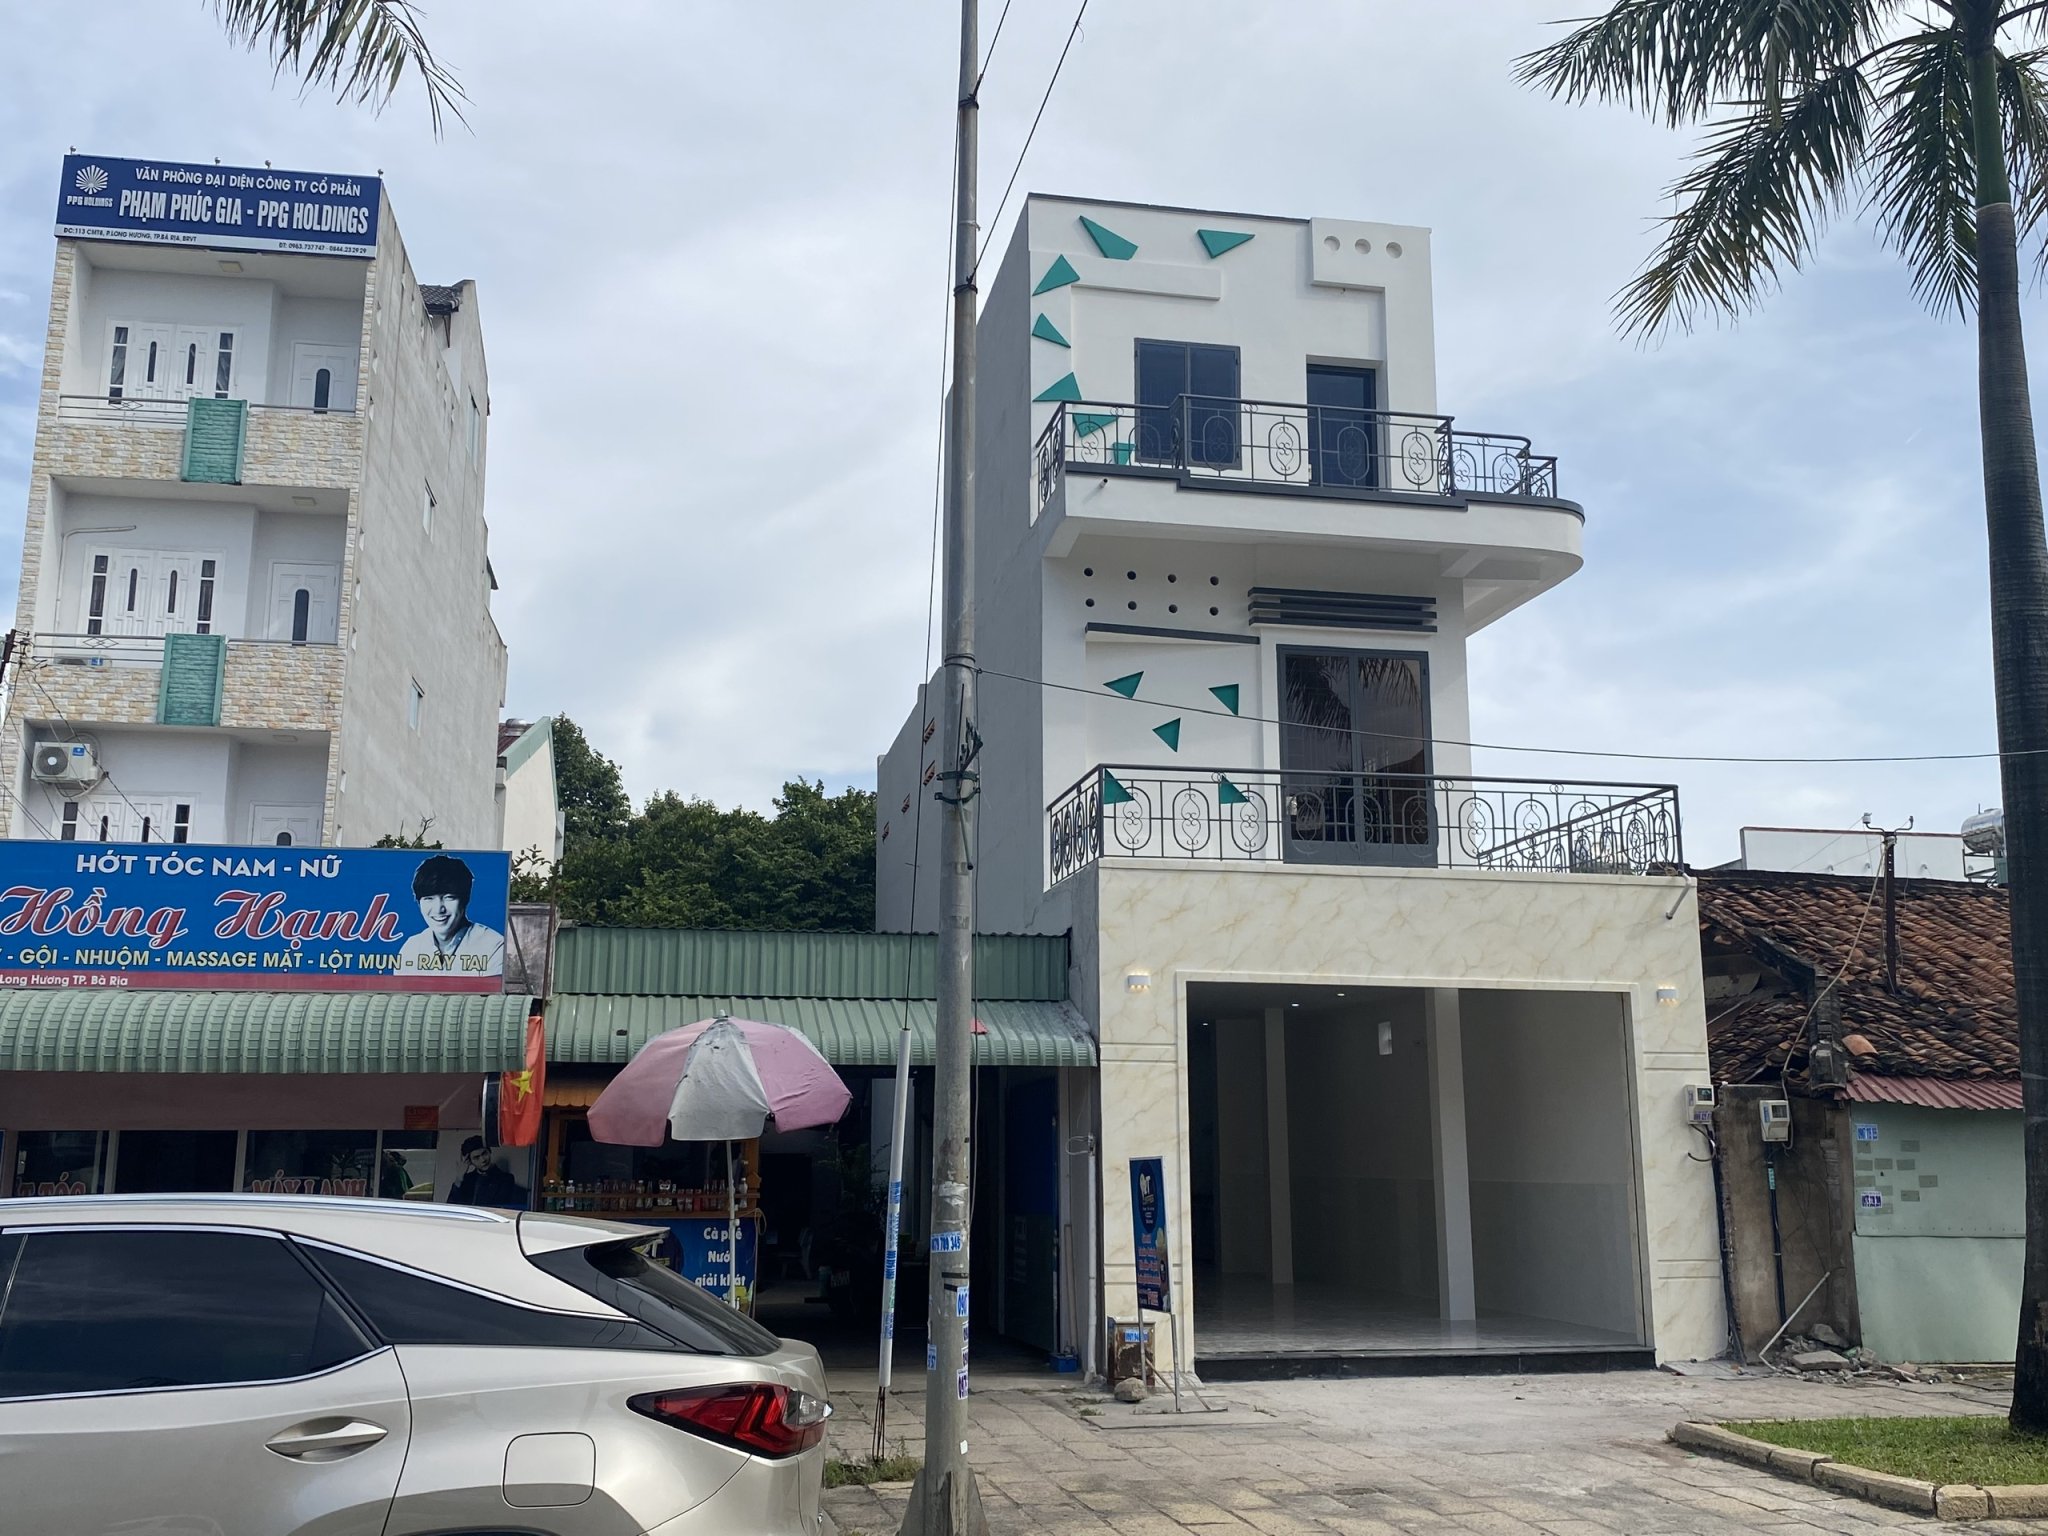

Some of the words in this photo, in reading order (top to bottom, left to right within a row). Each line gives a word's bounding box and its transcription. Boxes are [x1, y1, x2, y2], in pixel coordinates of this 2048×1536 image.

[135, 166, 159, 180] VĂN
[163, 168, 202, 184] PHÒNG
[205, 173, 226, 188] ĐẠI
[229, 173, 254, 190] DIỆN
[256, 176, 291, 191] CÔNG
[295, 180, 307, 192] TY
[310, 177, 328, 194] CỔ
[330, 179, 361, 197] PHẦN
[66, 195, 83, 206] PPG
[119, 190, 167, 222] PHẠM
[170, 190, 213, 223] PHÚC
[215, 196, 242, 225] GIA
[257, 200, 289, 229] PPG
[292, 202, 369, 234] HOLDINGS
[76, 850, 138, 874] HỚT
[145, 851, 205, 876] TÓC
[212, 857, 276, 877] NAM
[300, 854, 343, 878] NỮ
[0, 885, 188, 949] Hồng
[214, 889, 403, 949] Hạnh
[19, 944, 58, 969] GỘI
[75, 946, 149, 970] NHUỘM
[166, 951, 257, 968] MASSAGE
[263, 949, 304, 973] MẶT
[319, 949, 354, 974] LỘT
[359, 953, 402, 975] MỤN
[417, 951, 456, 971] RÁY
[460, 954, 488, 972] TAI
[0, 974, 28, 987] Long
[31, 974, 69, 987] Hương
[73, 975, 88, 986] TP.
[91, 975, 106, 987] Bà
[109, 976, 129, 988] Rịa
[703, 1227, 719, 1240] Cà
[721, 1227, 742, 1242] pê
[707, 1250, 732, 1263] Nướ
[720, 1273, 746, 1287] kát
